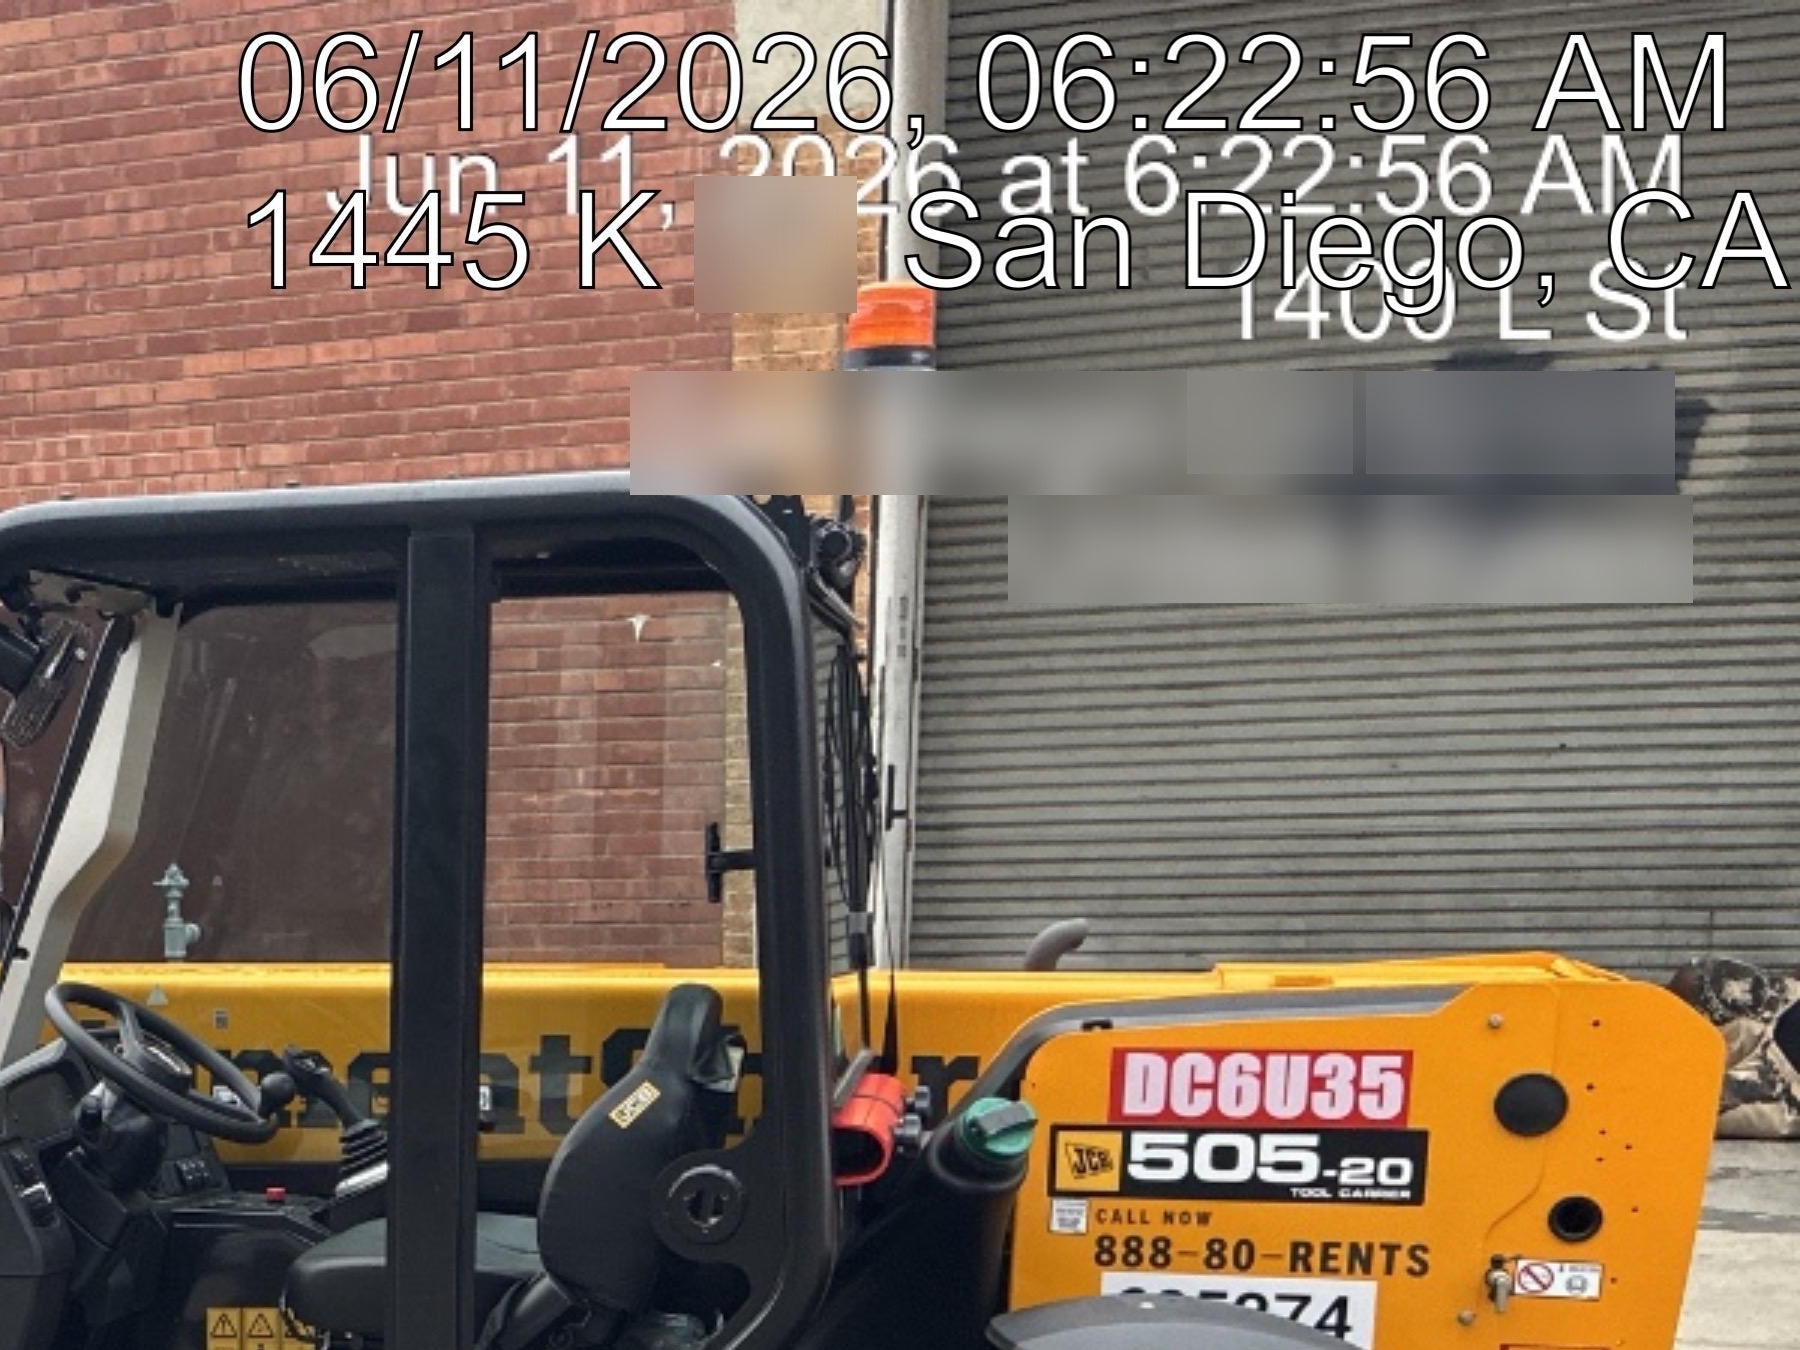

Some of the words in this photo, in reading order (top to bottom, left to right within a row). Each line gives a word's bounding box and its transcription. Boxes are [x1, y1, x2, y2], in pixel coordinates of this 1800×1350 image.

[1120, 1051, 1407, 1121] DC6U35
[1126, 1131, 1414, 1187] 505-20
[1289, 1186, 1333, 1199] TOOL
[1095, 1207, 1151, 1226] CALL
[1163, 1209, 1214, 1227] NOW
[1093, 1234, 1431, 1278] 888-80-RENTS
